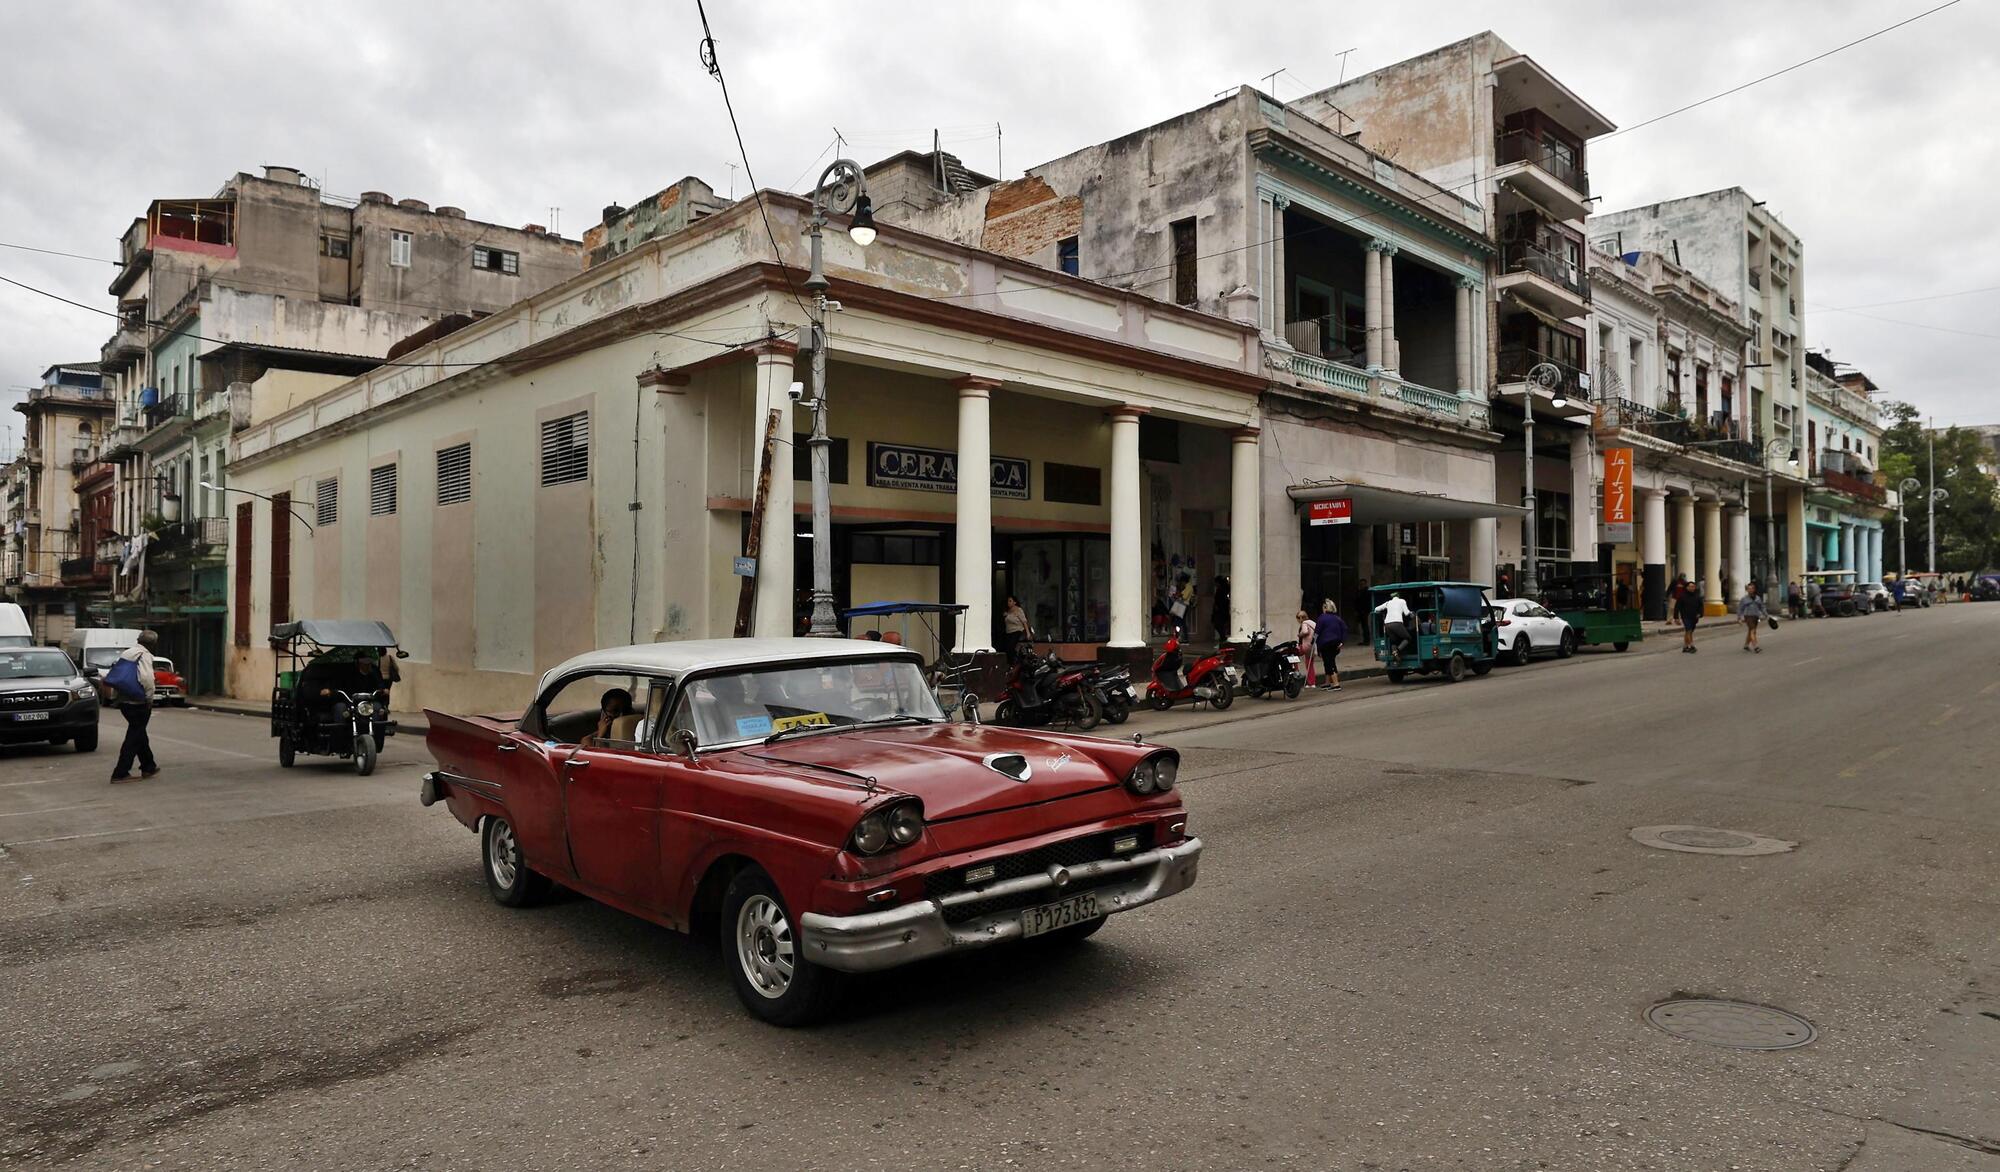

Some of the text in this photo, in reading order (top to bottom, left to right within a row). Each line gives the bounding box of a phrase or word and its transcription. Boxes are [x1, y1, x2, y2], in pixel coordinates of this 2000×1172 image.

[879, 450, 1024, 487] CERACA
[900, 481, 919, 489] VENTA
[783, 717, 824, 730] TAXI
